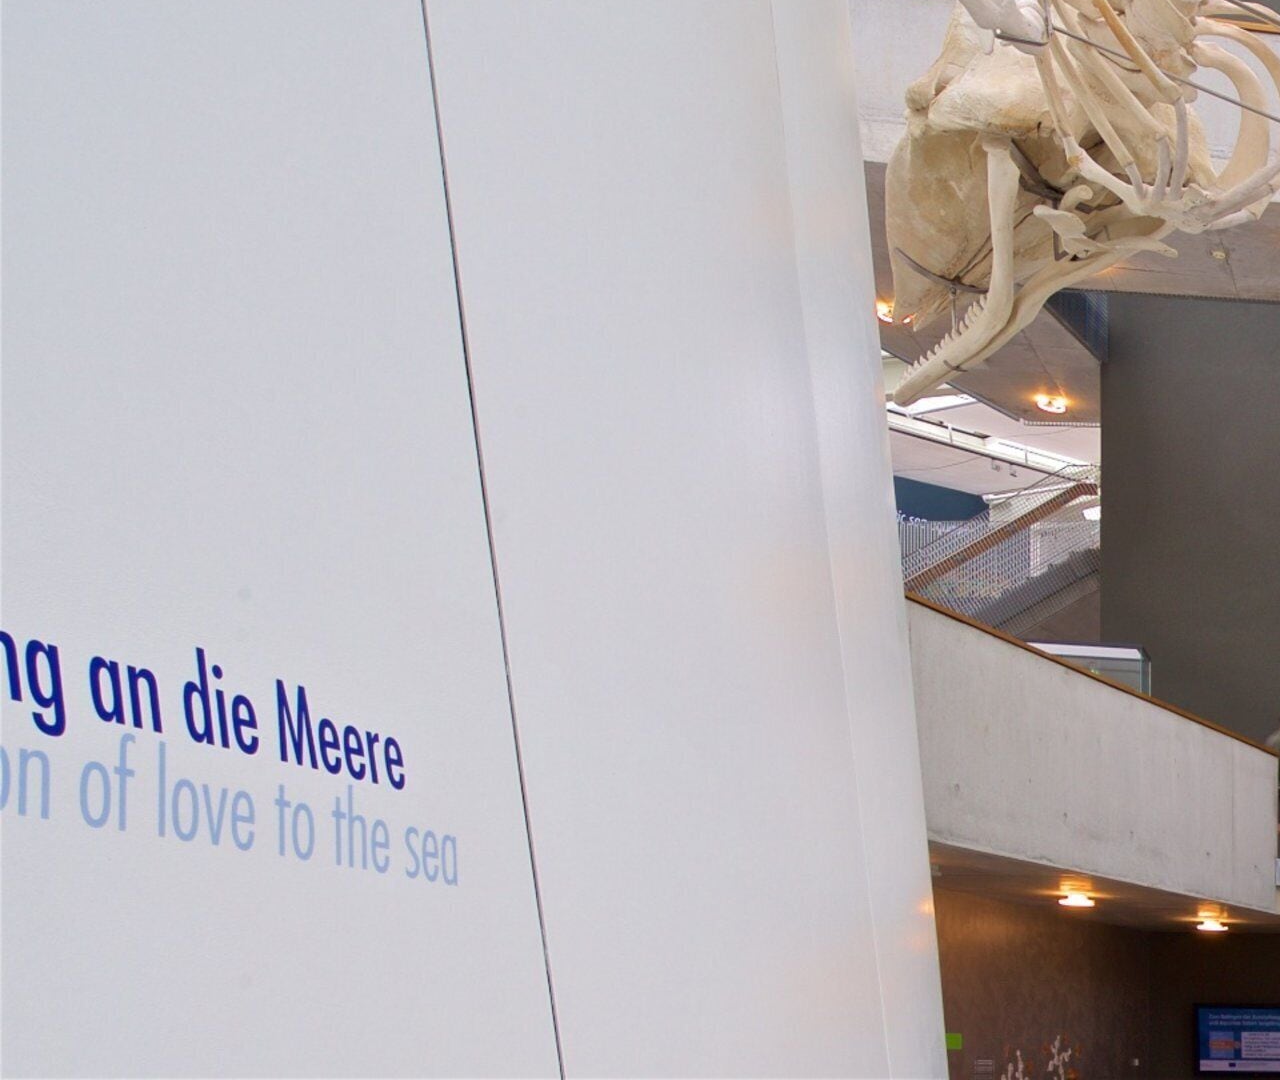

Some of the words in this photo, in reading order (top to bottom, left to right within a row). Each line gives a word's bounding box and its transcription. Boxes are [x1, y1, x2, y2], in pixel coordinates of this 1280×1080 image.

[89, 651, 163, 733] an
[183, 646, 260, 755] die
[276, 678, 406, 791] Meere
[80, 733, 136, 831] of
[157, 740, 256, 851] love
[275, 783, 316, 861] to
[332, 784, 390, 875] the
[404, 824, 459, 886] sea
